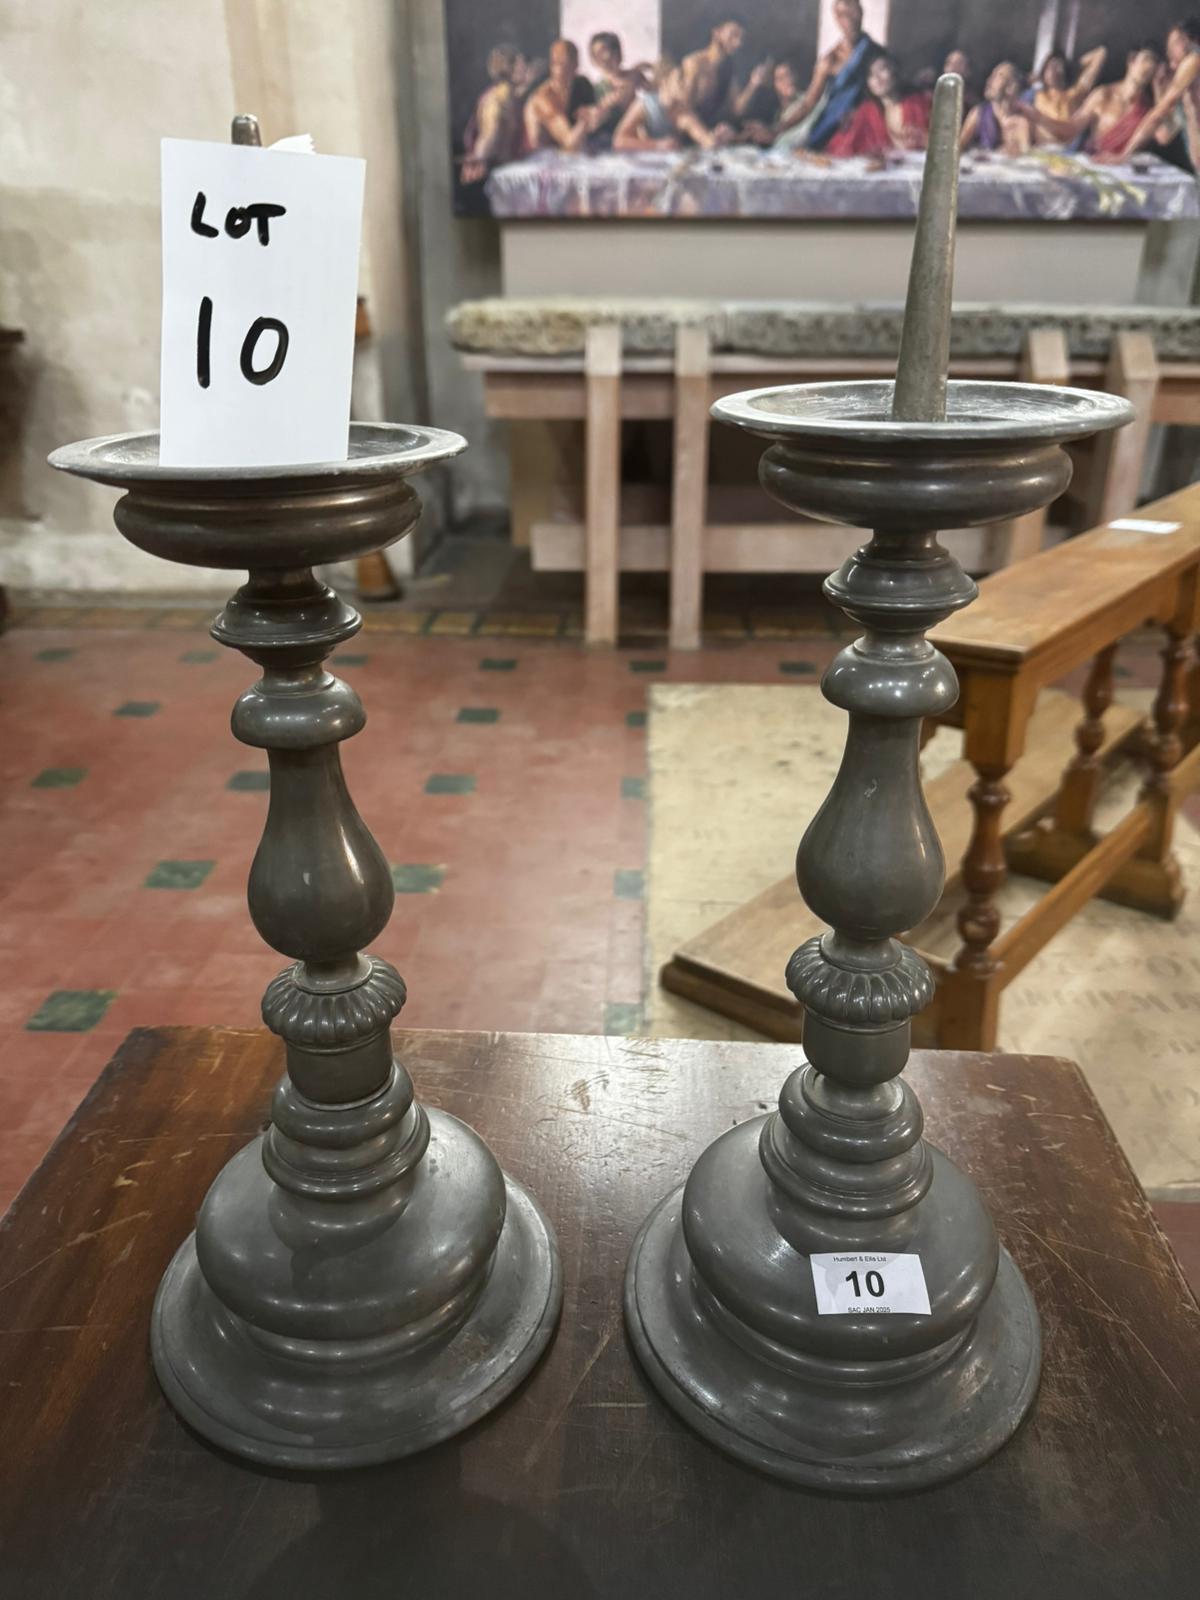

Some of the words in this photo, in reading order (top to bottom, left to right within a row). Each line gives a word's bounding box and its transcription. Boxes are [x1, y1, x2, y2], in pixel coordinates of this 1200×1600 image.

[191, 191, 287, 247] LOT
[196, 296, 290, 388] 10
[845, 1270, 885, 1298] 10
